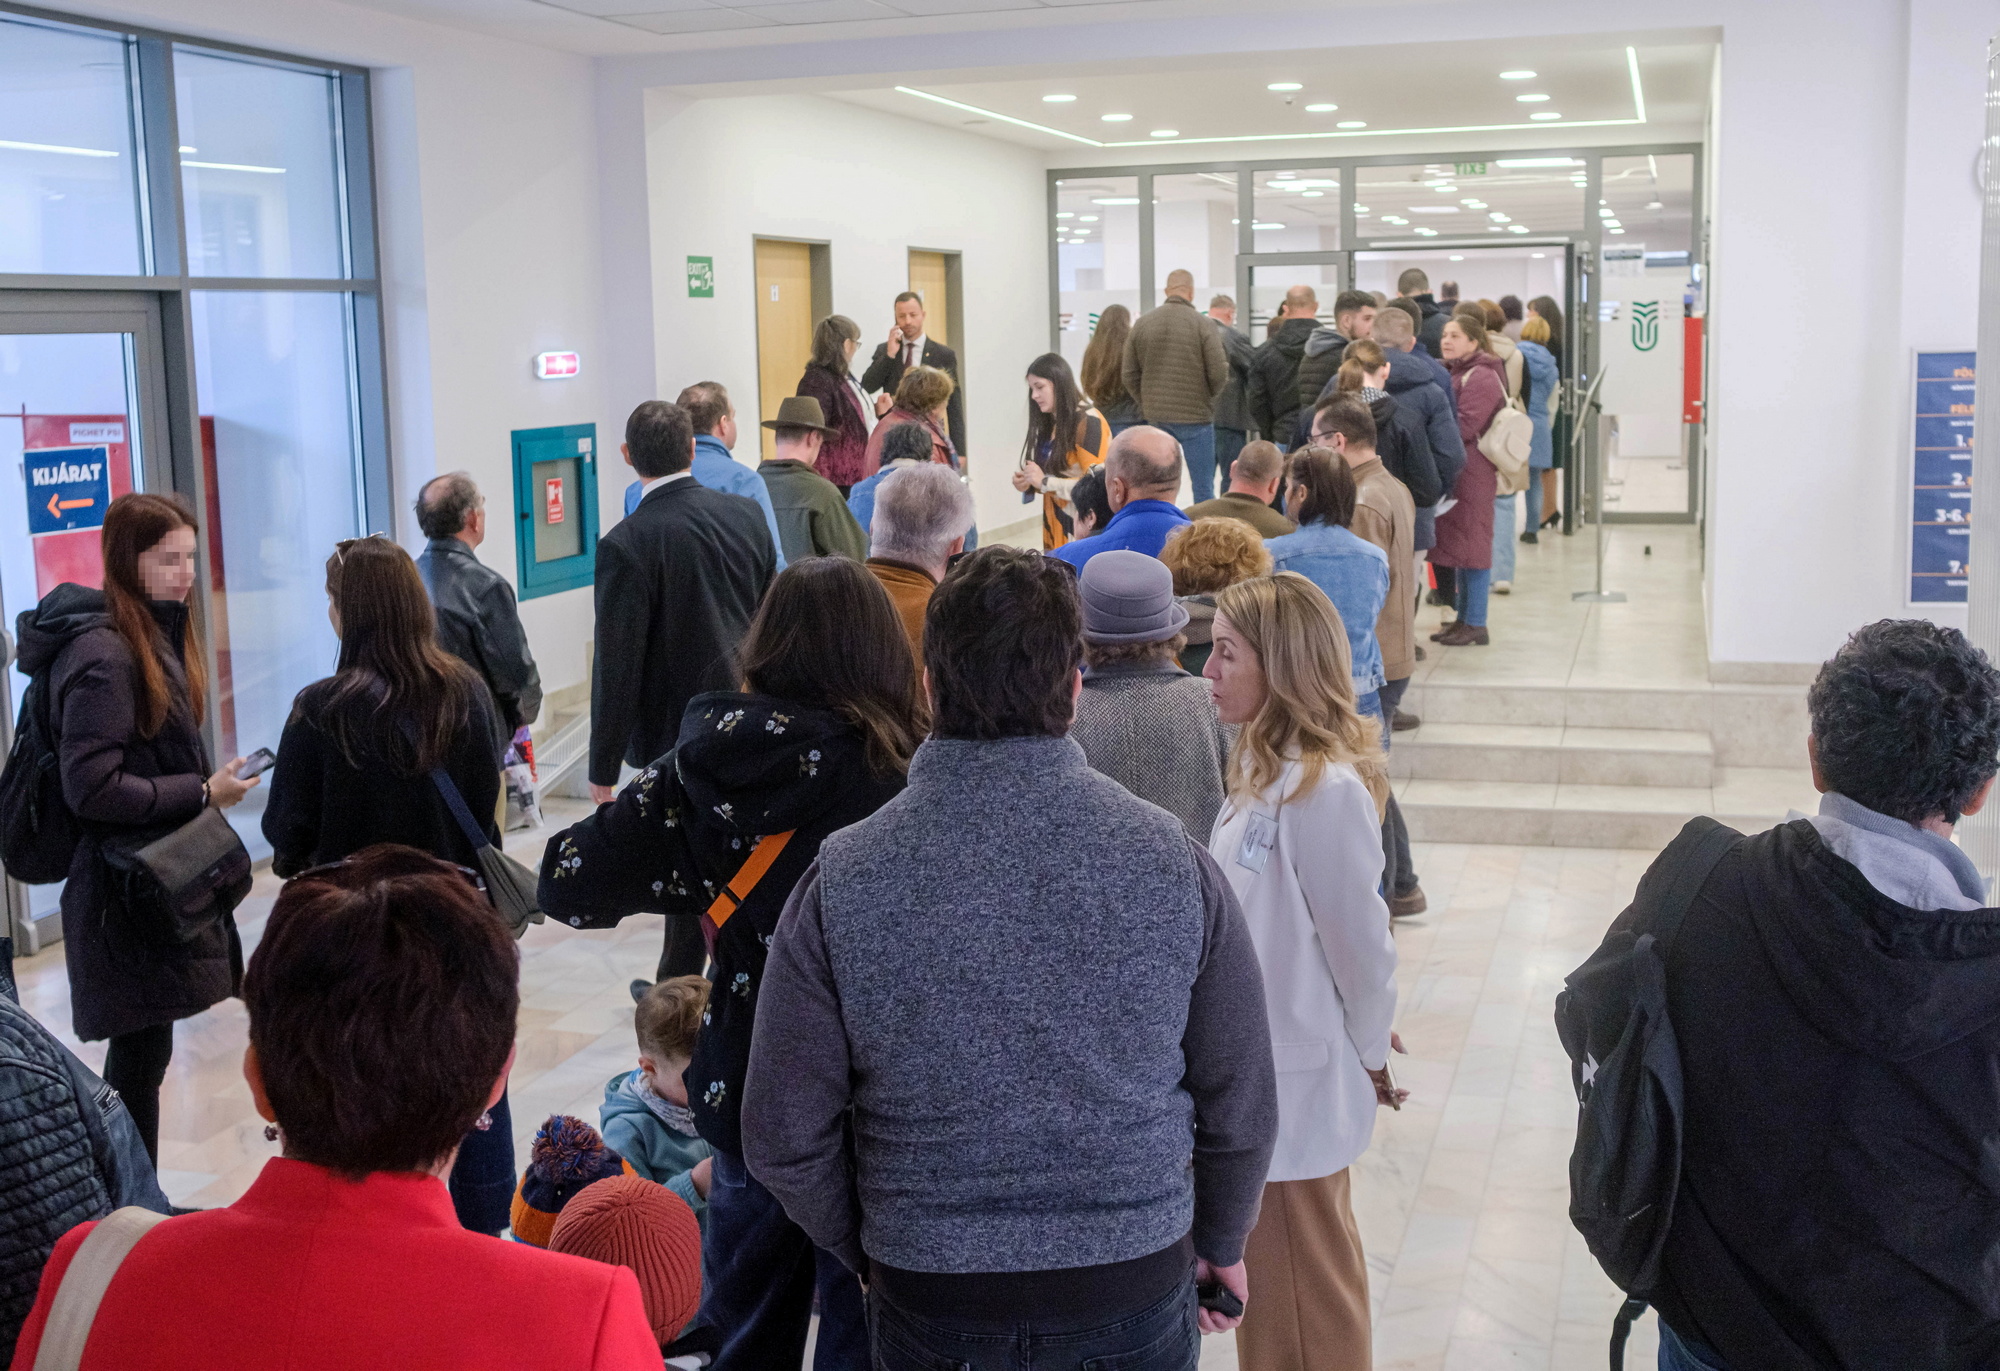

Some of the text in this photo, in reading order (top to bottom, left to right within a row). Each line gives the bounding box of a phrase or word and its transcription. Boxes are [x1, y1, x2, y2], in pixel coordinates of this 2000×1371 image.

[32, 461, 102, 487] KIJÁRAT
[1951, 472, 1966, 486] 2.
[1935, 508, 1965, 522] 3-6.
[1948, 560, 1963, 574] 7.
